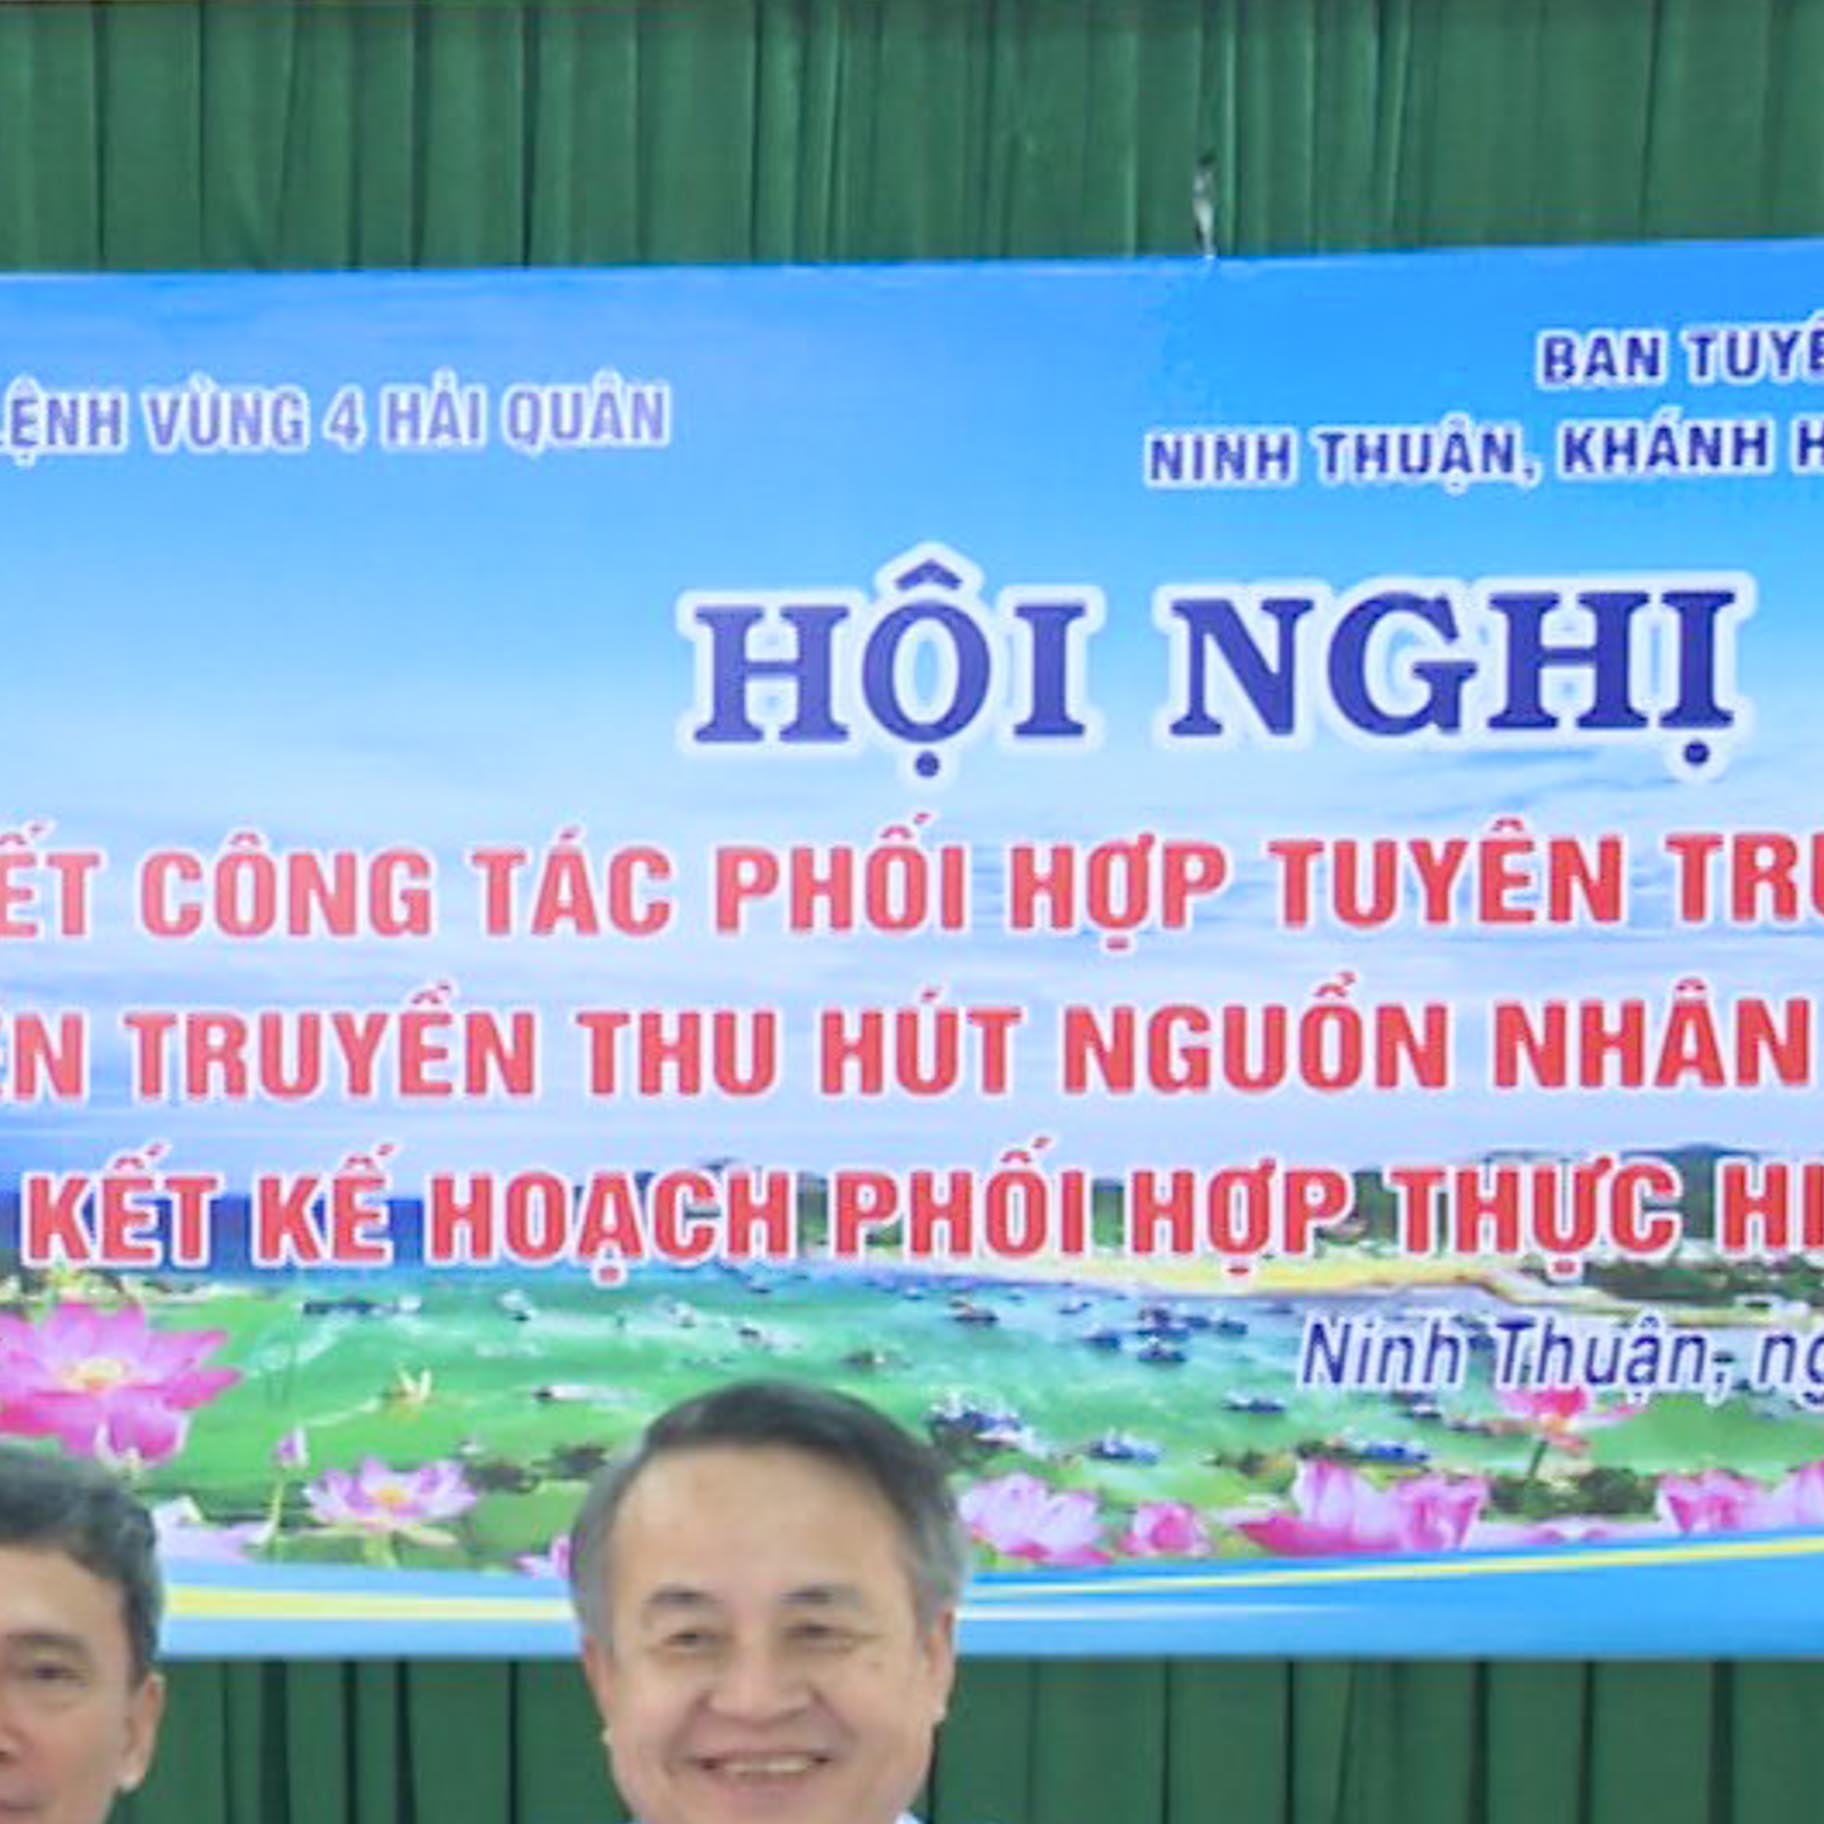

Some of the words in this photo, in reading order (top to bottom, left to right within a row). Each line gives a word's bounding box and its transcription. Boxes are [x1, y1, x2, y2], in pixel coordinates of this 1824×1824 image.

[1542, 334, 1661, 380] BAN
[144, 374, 306, 448] VÙNG
[326, 388, 362, 447] 4
[384, 371, 481, 443] HẢI
[506, 374, 665, 453] QUÂN
[1150, 431, 1292, 482] NINH
[1317, 416, 1536, 490] THUẬN,
[1562, 408, 1769, 473] KHÁNH
[693, 558, 1087, 779] HỘI
[1167, 589, 1739, 768] NGHỊ
[139, 831, 432, 938] CÔNG
[472, 828, 671, 937] TÁC
[714, 813, 965, 932] PHỐI
[1009, 832, 1227, 952] HỢP
[1268, 816, 1623, 929] TUYÊN
[1663, 831, 1824, 924] TR
[122, 978, 536, 1098] TRUYỀN
[574, 1007, 777, 1097] THU
[818, 987, 1023, 1095] HÚT
[1062, 969, 1448, 1095] NGUỒN
[1493, 976, 1811, 1090] NHÂN
[26, 1143, 221, 1262] KẾT
[256, 1144, 397, 1261] KẾ
[430, 1168, 793, 1282] HOẠCH
[834, 1136, 1089, 1258] PHỐI
[1130, 1157, 1354, 1276] HỢP
[1392, 1155, 1679, 1276] THỰC
[1299, 1314, 1462, 1387] Ninh
[1494, 1313, 1728, 1400] Thuận,
